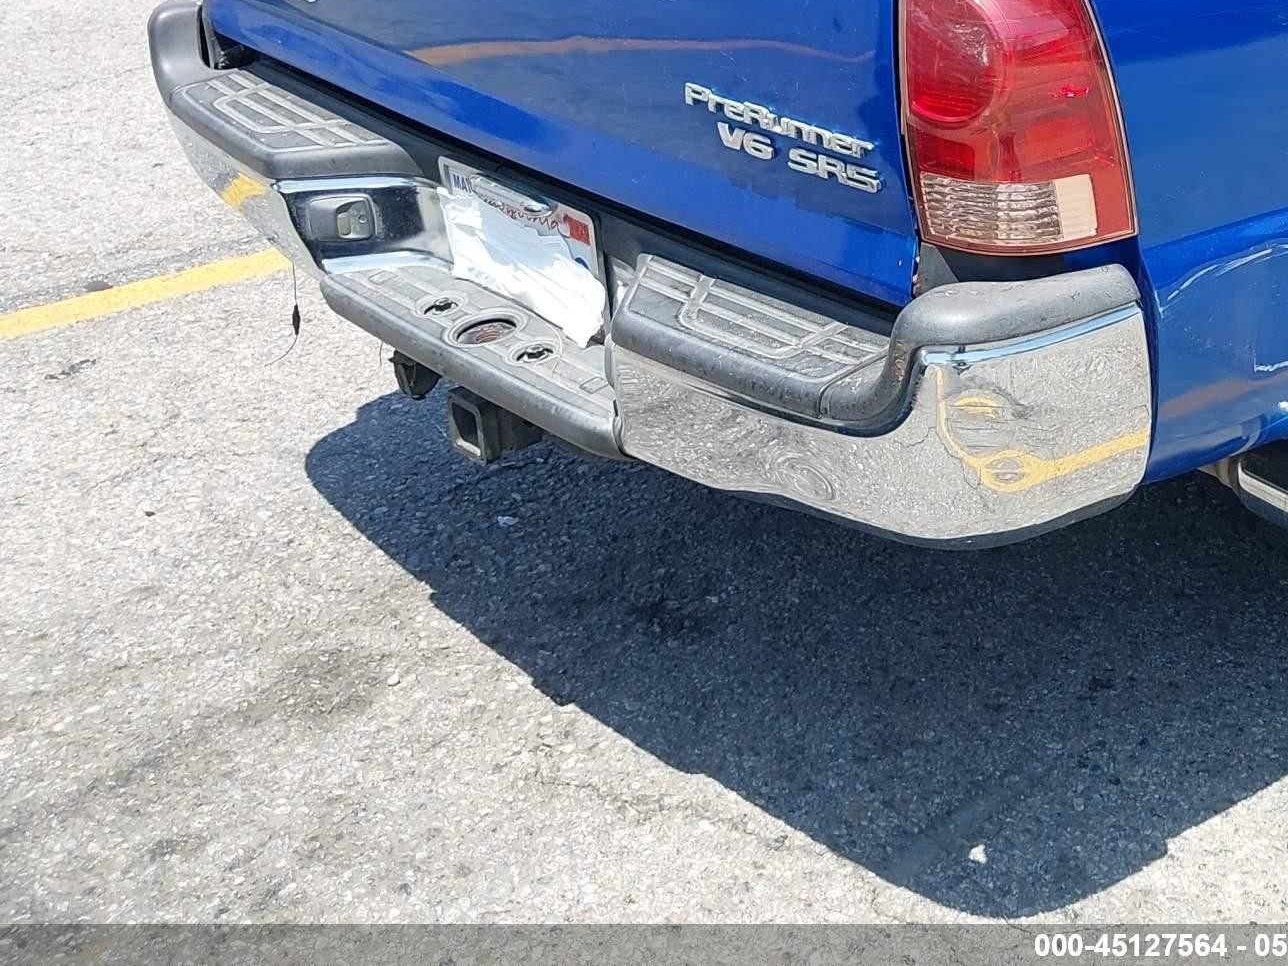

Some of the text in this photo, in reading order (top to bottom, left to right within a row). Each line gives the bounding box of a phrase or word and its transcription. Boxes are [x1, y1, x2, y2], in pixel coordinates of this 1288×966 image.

[685, 82, 875, 160] PreRunner
[717, 122, 883, 194] V6 SR5
